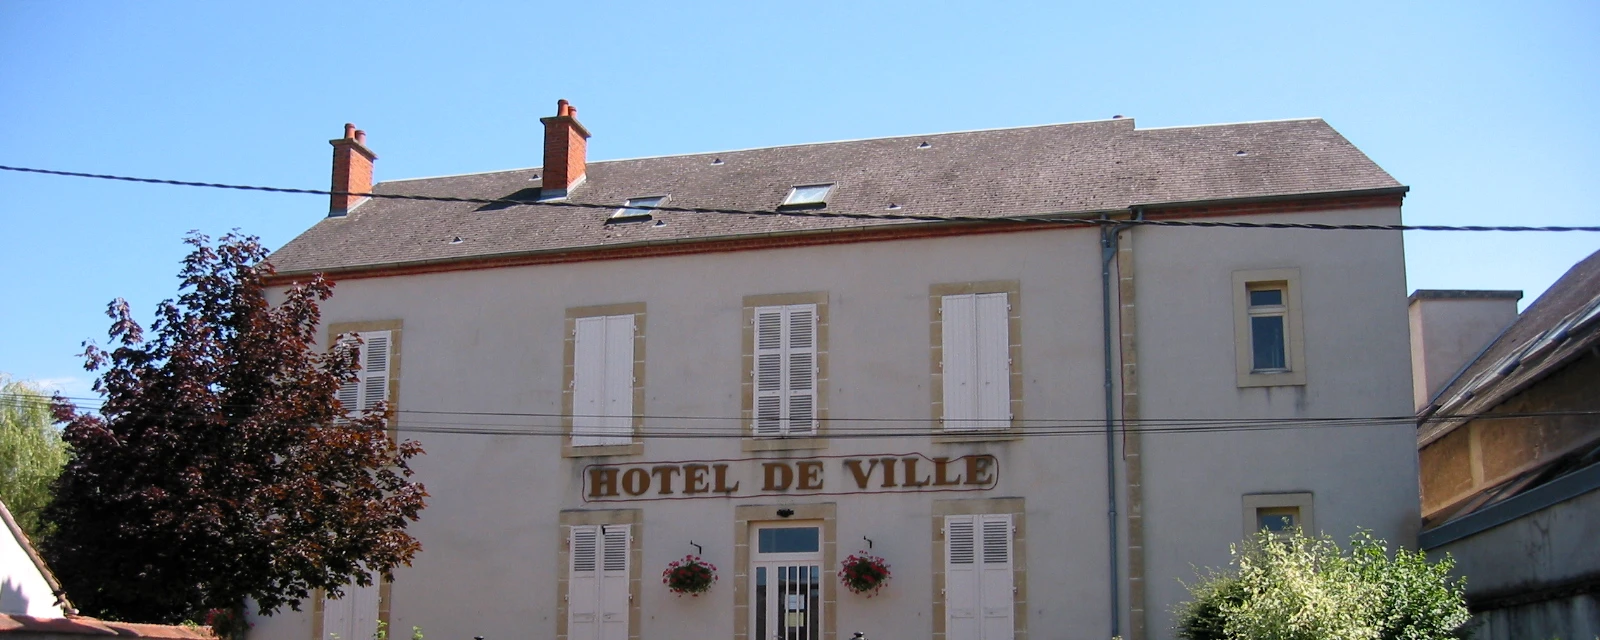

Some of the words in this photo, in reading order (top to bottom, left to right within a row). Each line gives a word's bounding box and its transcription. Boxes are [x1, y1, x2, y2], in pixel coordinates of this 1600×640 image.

[588, 464, 740, 497] HOTEL
[761, 461, 824, 491] DE
[844, 455, 993, 489] VILLE
